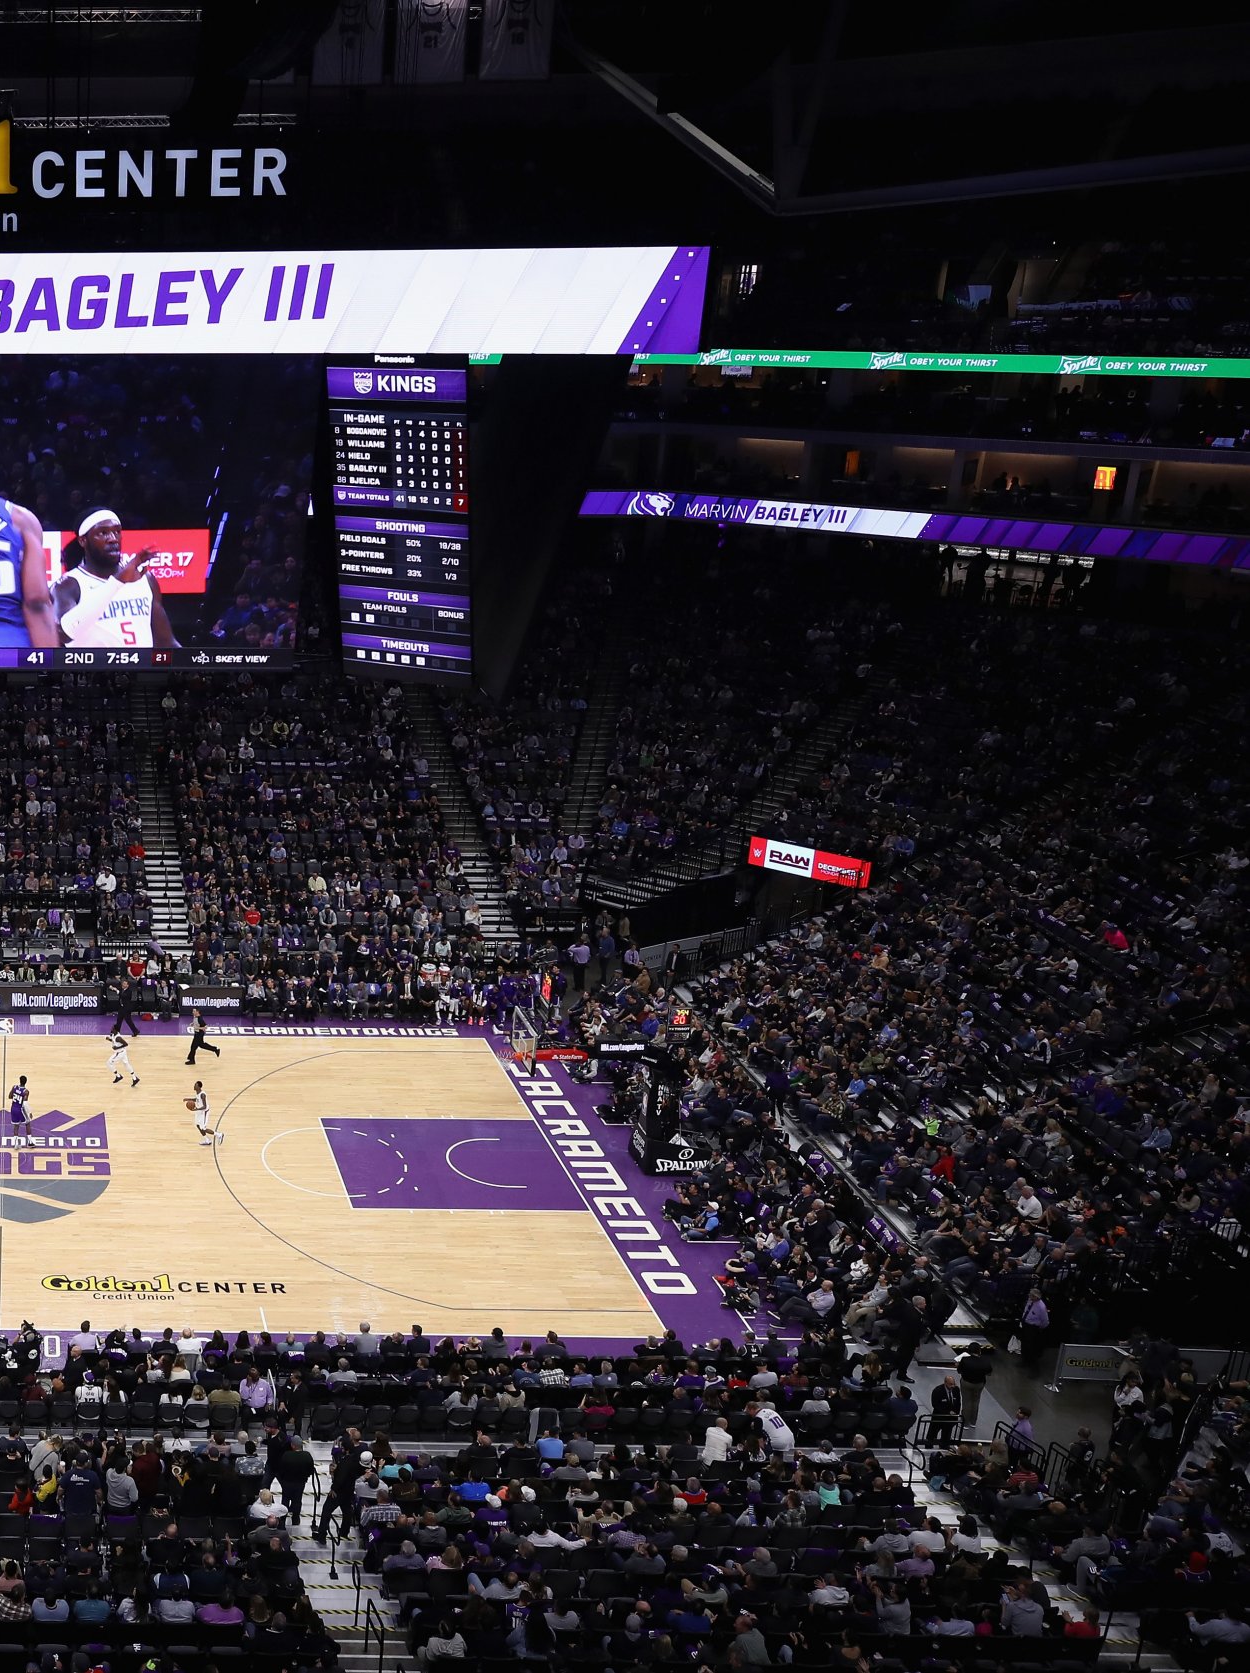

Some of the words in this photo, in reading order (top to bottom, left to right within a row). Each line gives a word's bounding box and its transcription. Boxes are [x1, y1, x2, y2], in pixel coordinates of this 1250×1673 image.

[32, 149, 287, 198] CENTER
[263, 264, 335, 321] III
[375, 355, 415, 363] Panasonic
[734, 354, 756, 362] OBEY
[758, 354, 780, 362] YOUR
[783, 355, 811, 363] THIRST
[873, 352, 903, 369] Sprite
[909, 358, 934, 366] OBEY
[938, 358, 963, 367] YOUR
[965, 358, 998, 367] THIRST
[1060, 356, 1098, 374] Sprite
[1105, 362, 1133, 370] OBEY
[1137, 362, 1167, 371] YOUR
[1170, 363, 1207, 372] THIRST
[377, 375, 436, 393] KINGS
[344, 414, 385, 424] IN-GAME
[347, 440, 385, 448] WILLIAMS
[348, 452, 370, 460] HIELD
[349, 465, 378, 473] BAGLEY
[349, 477, 380, 485] BJELICA
[684, 503, 749, 519] MARVIN
[755, 506, 824, 522] BAGLEY
[828, 510, 847, 523] III
[376, 521, 425, 533] SHOOTING
[340, 534, 360, 542] FIELD
[362, 536, 386, 544] GOALS
[176, 552, 194, 567] 17
[341, 549, 385, 559] 3-POINTERS
[342, 564, 360, 572] FREE
[361, 565, 393, 575] THROWS
[388, 592, 418, 602] FOULS
[362, 603, 382, 611] TEAM
[384, 605, 407, 613] FOULS
[438, 610, 464, 619] BONUS
[120, 622, 137, 645] 5
[381, 639, 429, 652] TIMEOUTS
[27, 652, 44, 663] 41
[65, 652, 94, 663] 2ND
[106, 652, 139, 663] 7:54
[215, 655, 243, 663] SKEYE
[245, 655, 269, 663] VIEW
[770, 850, 810, 866] RAW
[11, 994, 98, 1010] NBA.com/LeaguePass
[182, 996, 240, 1009] NBA.com/LeaguePass
[674, 1016, 685, 1024] 20
[13, 1095, 22, 1104] 24
[655, 1159, 709, 1172] SPALDIN
[41, 1274, 175, 1292] Golden1
[178, 1282, 287, 1293] CENTER
